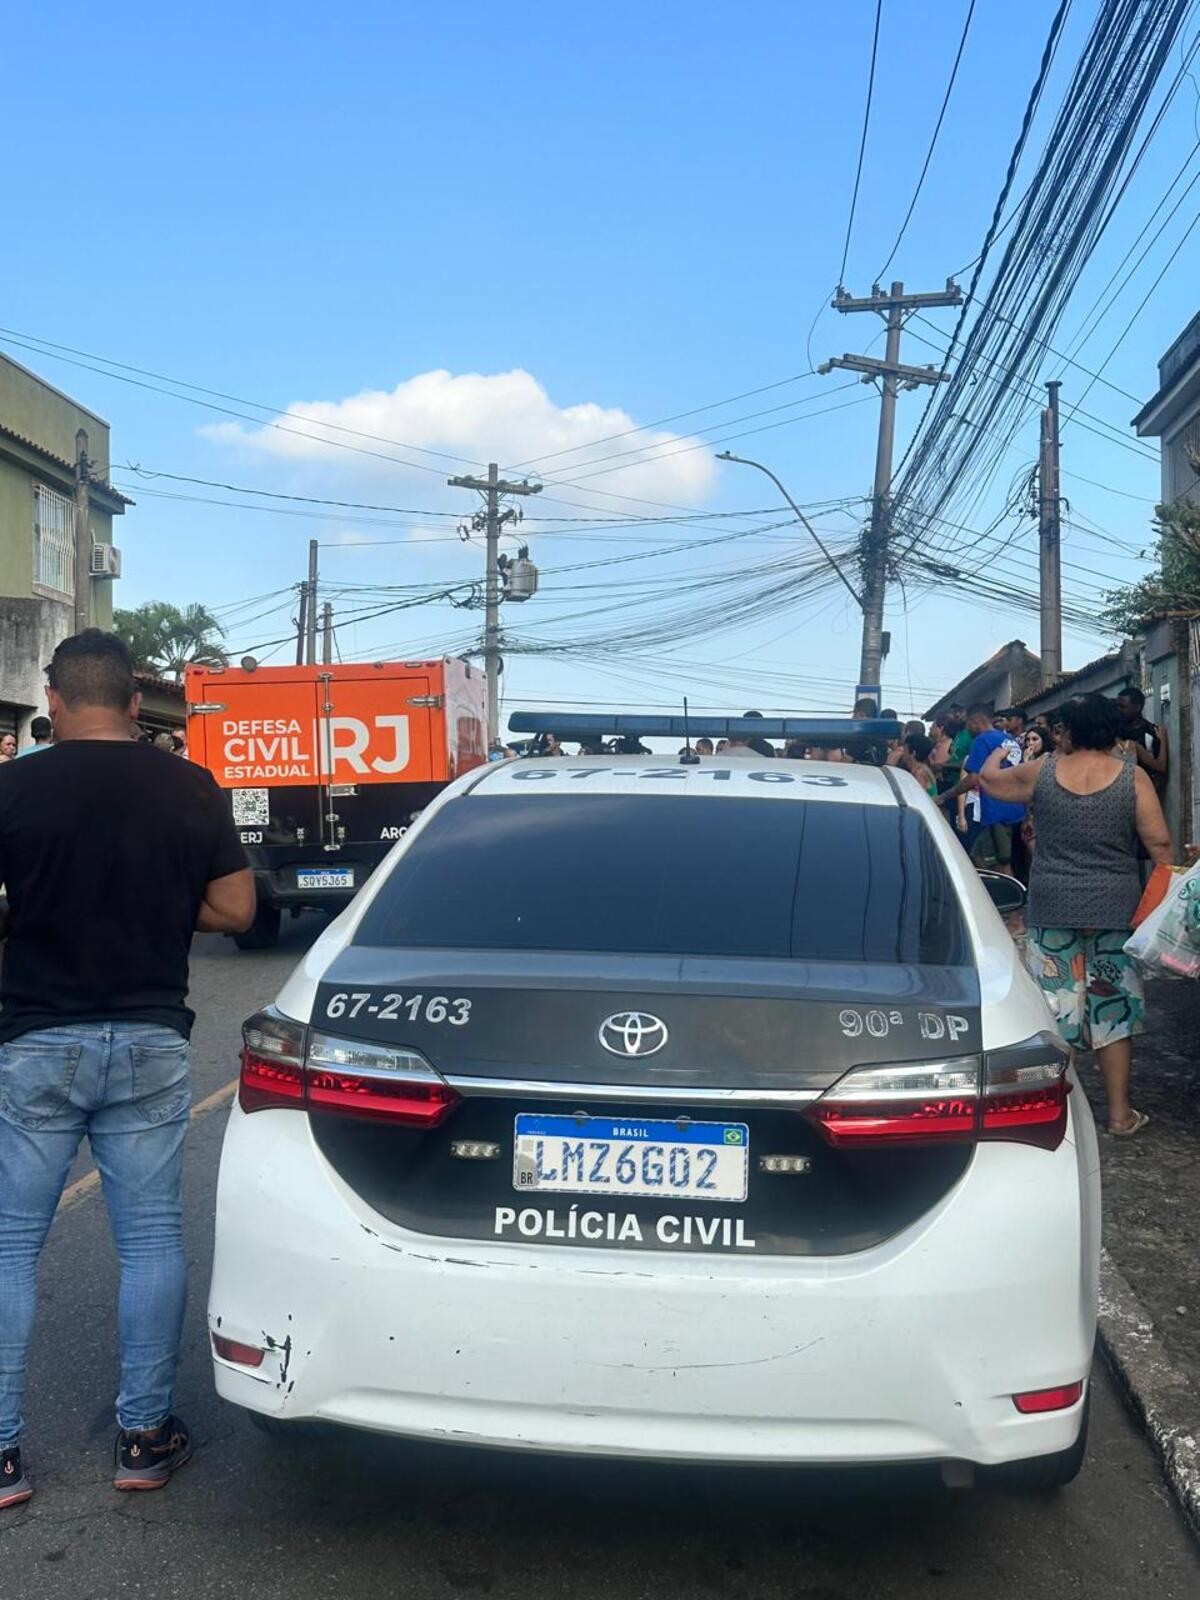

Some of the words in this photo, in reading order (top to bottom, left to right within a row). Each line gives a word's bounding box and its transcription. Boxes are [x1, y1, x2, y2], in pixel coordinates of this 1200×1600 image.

[223, 720, 301, 735] DEFESA
[224, 737, 309, 762] CIVIL
[319, 714, 410, 775] RJ
[224, 765, 310, 779] ESTADUAL
[511, 768, 849, 788] 67-2163
[326, 993, 472, 1026] 67-2163
[839, 1009, 904, 1038] 90ª
[918, 1012, 969, 1041] DP
[612, 1127, 649, 1138] BRASIL
[535, 1140, 718, 1190] LMZ6G02
[520, 1171, 534, 1185] BR
[494, 1203, 644, 1242] POLÍCIA
[656, 1215, 756, 1248] CIVIL
